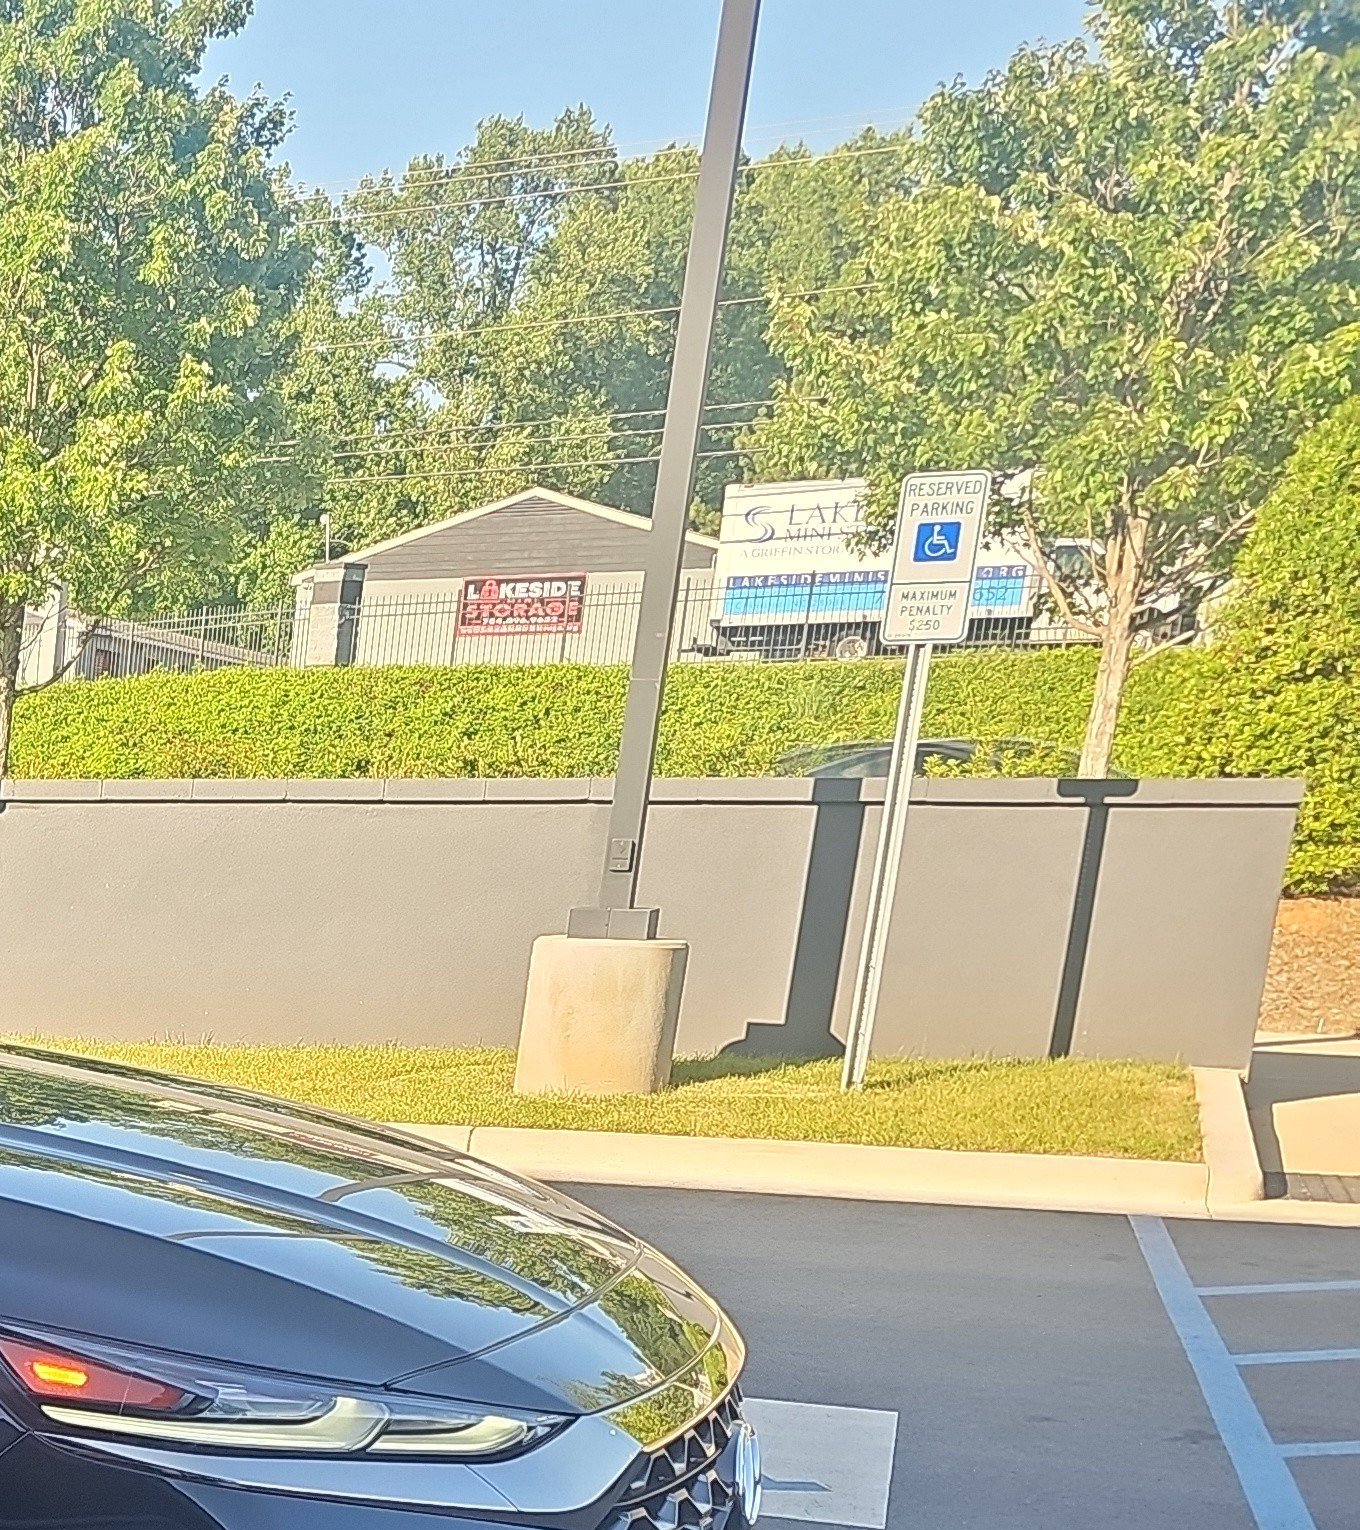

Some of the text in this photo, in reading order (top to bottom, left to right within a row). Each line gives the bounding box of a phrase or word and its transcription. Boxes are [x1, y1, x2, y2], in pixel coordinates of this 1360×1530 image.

[908, 480, 983, 498] RESERVED
[910, 500, 975, 517] PARKING
[900, 589, 958, 602] MAXIMUM
[465, 601, 580, 619] STORAGE
[899, 604, 953, 617] PENALTY
[908, 619, 941, 632] $250
